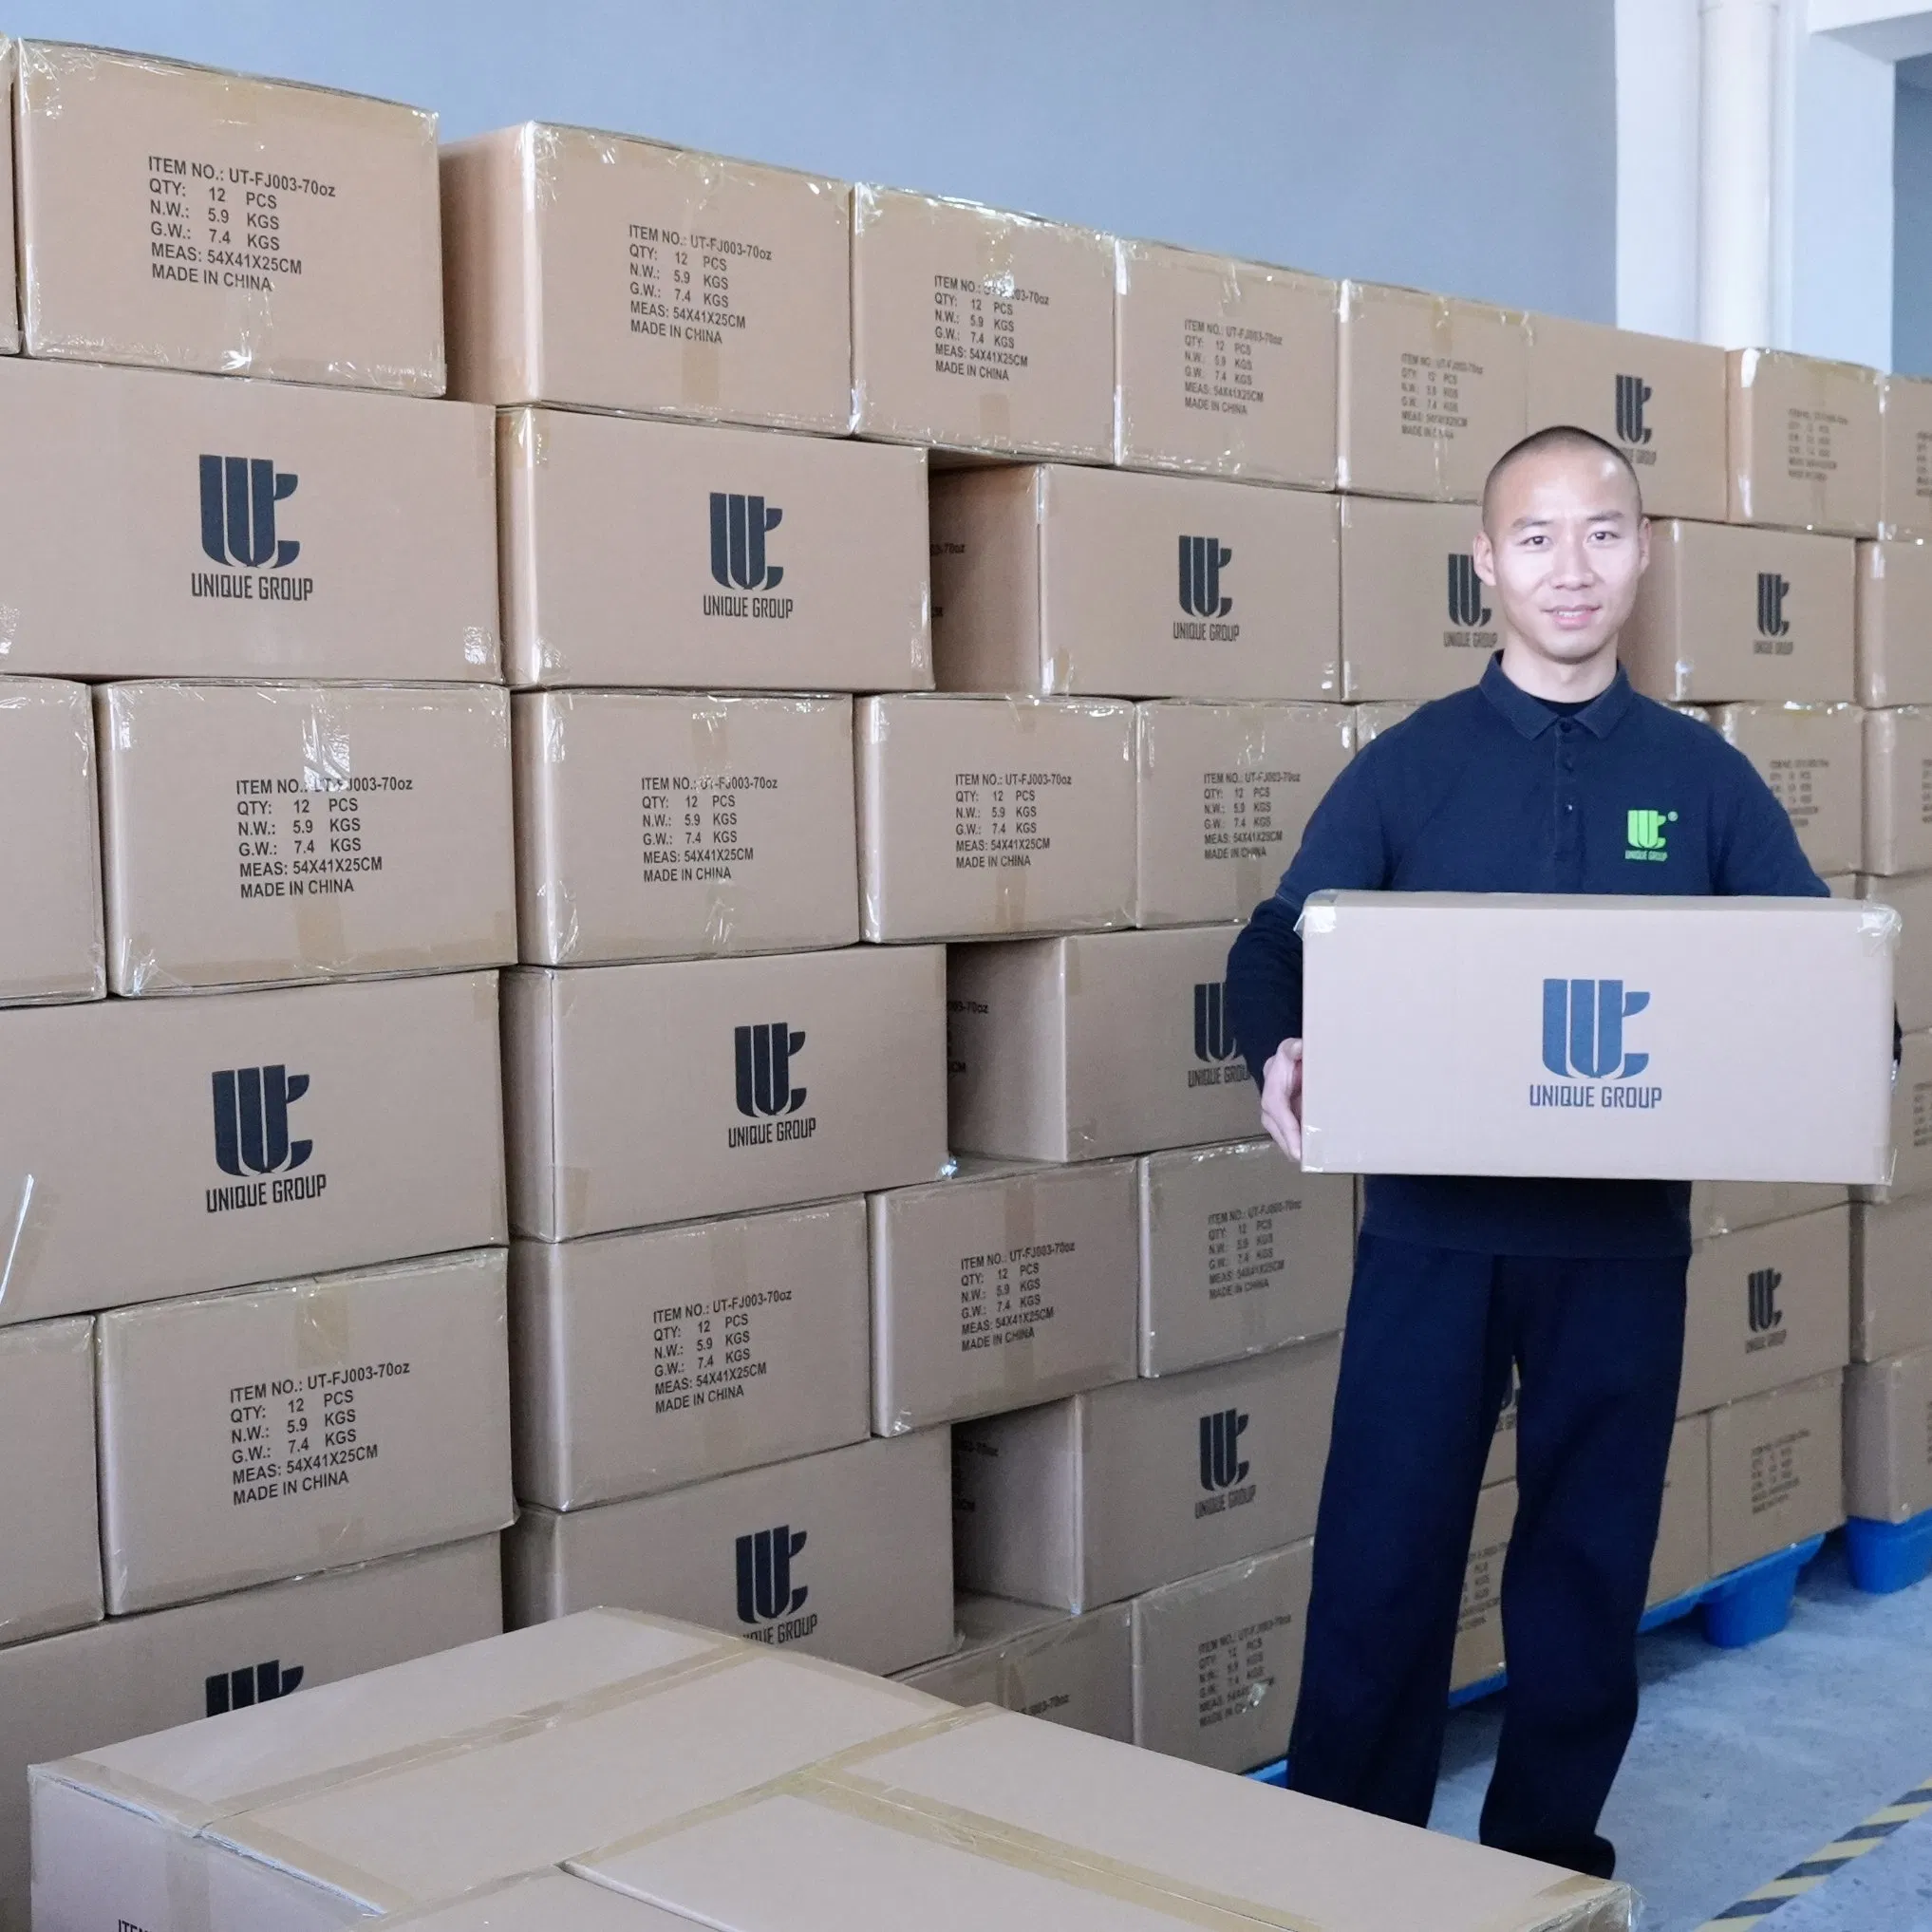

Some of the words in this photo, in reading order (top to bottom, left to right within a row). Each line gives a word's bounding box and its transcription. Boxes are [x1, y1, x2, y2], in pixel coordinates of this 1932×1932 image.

[147, 155, 187, 176] ITEM
[191, 161, 224, 181] NO.:
[228, 166, 336, 197] UT-FJ003-70oz
[148, 177, 186, 197] QTY:
[208, 185, 226, 202] 12
[245, 191, 277, 210] PCS
[149, 197, 189, 218] N.W.:
[207, 206, 230, 224] 5.9
[246, 212, 279, 231] KGS
[149, 219, 191, 240] G.W.:
[208, 227, 231, 245] 7.4
[247, 233, 280, 252] KGS
[628, 223, 659, 242] ITEM
[662, 229, 687, 247] NO.:
[689, 234, 772, 261] UT-FJ003-70oz
[151, 241, 201, 263] MEAS:
[206, 247, 302, 275] 54X41X25CM
[628, 242, 658, 261] QTY:
[674, 250, 687, 266] 12
[703, 254, 727, 272] PCS
[151, 262, 198, 284] MADE
[202, 269, 218, 286] IN
[222, 271, 272, 292] CHINA
[629, 261, 660, 279] N.W.:
[673, 269, 690, 285] 5.9
[703, 273, 728, 291] KGS
[629, 280, 661, 298] G.W.:
[673, 287, 691, 303] 7.4
[703, 291, 729, 309] KGS
[933, 291, 957, 308] QTY:
[970, 297, 982, 310] 12
[993, 301, 1013, 316] PCS
[629, 299, 669, 319] MEAS:
[672, 305, 745, 329] 54X41X25CM
[629, 318, 666, 337] MADE
[669, 324, 682, 339] IN
[685, 326, 722, 345] CHINA
[935, 359, 965, 376] MADE
[966, 364, 977, 377] IN
[978, 365, 1009, 382] CHINA
[190, 572, 253, 599] UNIQUE
[257, 575, 314, 602] GROUP
[703, 594, 749, 617] UNIQUE
[752, 597, 794, 619] GROUP
[1172, 621, 1207, 641] UNIQUE
[1209, 624, 1240, 644] GROUP
[235, 778, 272, 795] ITEM
[641, 777, 669, 791] ITEM
[672, 777, 697, 790] NO.:
[955, 773, 980, 785] ITEM
[982, 773, 1003, 785] NO.:
[235, 799, 272, 816] QTY:
[292, 798, 309, 814] 12
[328, 797, 358, 812] PCS
[641, 795, 669, 809] QTY:
[685, 795, 698, 808] 12
[711, 794, 736, 807] PCS
[955, 790, 979, 802] QTY:
[992, 790, 1004, 801] 12
[1015, 789, 1036, 801] PCS
[237, 819, 275, 835] N.W.:
[291, 818, 313, 835] 5.9
[328, 816, 361, 833] KGS
[642, 814, 671, 827] N.W.:
[684, 813, 701, 826] 5.9
[712, 812, 737, 826] KGS
[955, 806, 981, 818] N.W.:
[991, 806, 1005, 818] 5.9
[1015, 805, 1037, 817] KGS
[642, 832, 672, 846] G.W.:
[685, 831, 702, 844] 7.4
[712, 830, 738, 843] KGS
[955, 822, 981, 835] G.W.:
[991, 822, 1006, 835] 7.4
[1015, 821, 1037, 834] KGS
[237, 840, 277, 856] G.W.:
[293, 838, 315, 854] 7.4
[329, 837, 362, 853] KGS
[643, 850, 681, 864] MEAS:
[684, 847, 754, 862] 54X41X25CM
[955, 839, 987, 852] MEAS:
[990, 837, 1050, 851] 54X41X25CM
[239, 860, 288, 877] MEAS:
[291, 855, 383, 874] 54X41X25CM
[643, 868, 678, 882] MADE
[681, 867, 693, 881] IN
[695, 866, 732, 880] CHINA
[955, 855, 985, 869] MADE
[987, 854, 998, 868] IN
[1000, 854, 1032, 867] CHINA
[239, 881, 285, 898] MADE
[289, 880, 304, 895] IN
[308, 877, 355, 894] CHINA
[1529, 1084, 1596, 1108] UNIQUE
[1602, 1086, 1662, 1109] GROUP
[728, 1123, 773, 1149] UNIQUE
[777, 1117, 816, 1142] GROUP
[206, 1182, 267, 1213] UNIQUE
[272, 1173, 327, 1203] GROUP
[652, 1305, 682, 1323] ITEM
[685, 1301, 709, 1319] NO.:
[712, 1286, 792, 1313] UT-FJ003-70oz
[652, 1324, 681, 1342] QTY:
[697, 1319, 710, 1334] 12
[724, 1312, 748, 1329] PCS
[653, 1341, 684, 1360] N.W.:
[696, 1336, 713, 1352] 5.9
[724, 1329, 750, 1346] KGS
[653, 1360, 685, 1378] G.W.:
[697, 1354, 714, 1370] 7.4
[725, 1347, 750, 1364] KGS
[229, 1382, 267, 1403] ITEM
[271, 1377, 303, 1397] NO.:
[307, 1359, 410, 1390] UT-FJ003-70oz
[654, 1376, 692, 1396] MEAS:
[695, 1361, 766, 1387] 54X41X25CM
[230, 1403, 266, 1424] QTY:
[287, 1397, 305, 1414] 12
[323, 1388, 354, 1407] PCS
[654, 1394, 690, 1414] MADE
[692, 1391, 704, 1406] IN
[707, 1383, 744, 1403] CHINA
[231, 1423, 269, 1444] N.W.:
[286, 1416, 308, 1435] 5.9
[324, 1408, 356, 1428] KGS
[231, 1443, 271, 1464] G.W.:
[287, 1436, 309, 1454] 7.4
[324, 1428, 357, 1447] KGS
[232, 1461, 281, 1485] MEAS:
[286, 1443, 378, 1474] 54X41X25CM
[233, 1482, 278, 1506] MADE
[282, 1478, 297, 1495] IN
[301, 1469, 349, 1491] CHINA
[777, 1613, 817, 1644] GROUP
